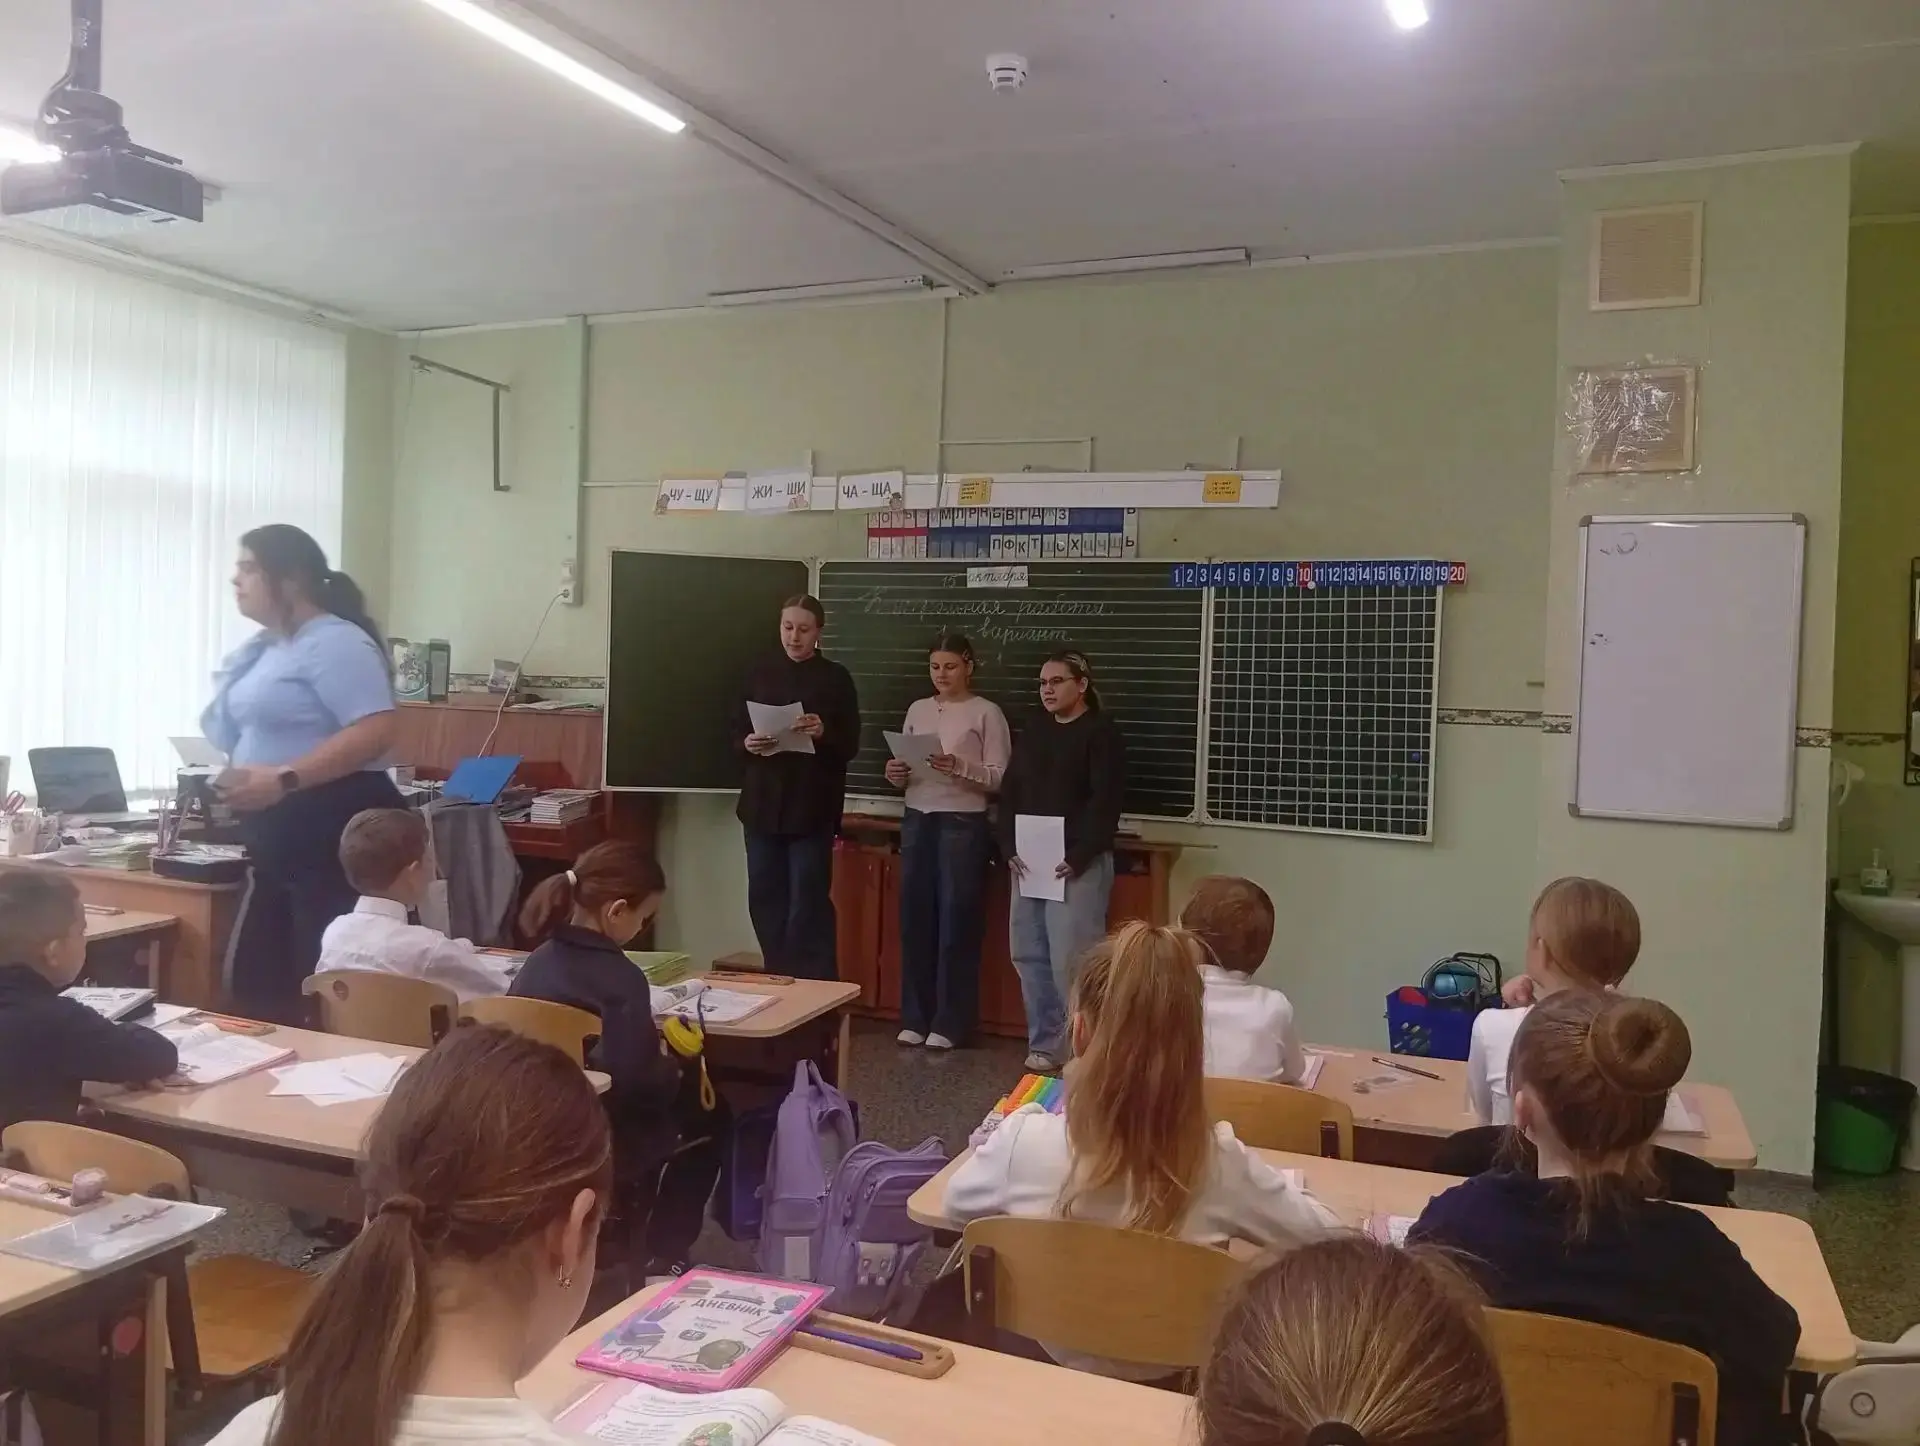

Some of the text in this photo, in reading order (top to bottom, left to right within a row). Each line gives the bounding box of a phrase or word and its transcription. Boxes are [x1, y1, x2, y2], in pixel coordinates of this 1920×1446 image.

[669, 487, 684, 501] ЧУ
[694, 487, 713, 503] ЩУ
[751, 484, 772, 499] ЖИ
[786, 481, 806, 496] ШИ
[842, 485, 858, 498] ЧА
[871, 481, 891, 498] ЩА
[1006, 508, 1014, 521] В
[1058, 508, 1067, 520] З
[992, 539, 1001, 551] П
[1004, 539, 1014, 551] Ф
[1018, 541, 1026, 554] К
[1031, 538, 1040, 550] Т
[1070, 539, 1079, 550] Х
[1173, 566, 1465, 582] 1 2 3 4 5 6 7 8 9 10 11 12 13 14 15 16 17 18 19 20
[690, 1298, 762, 1317] ДНЕВНИК
